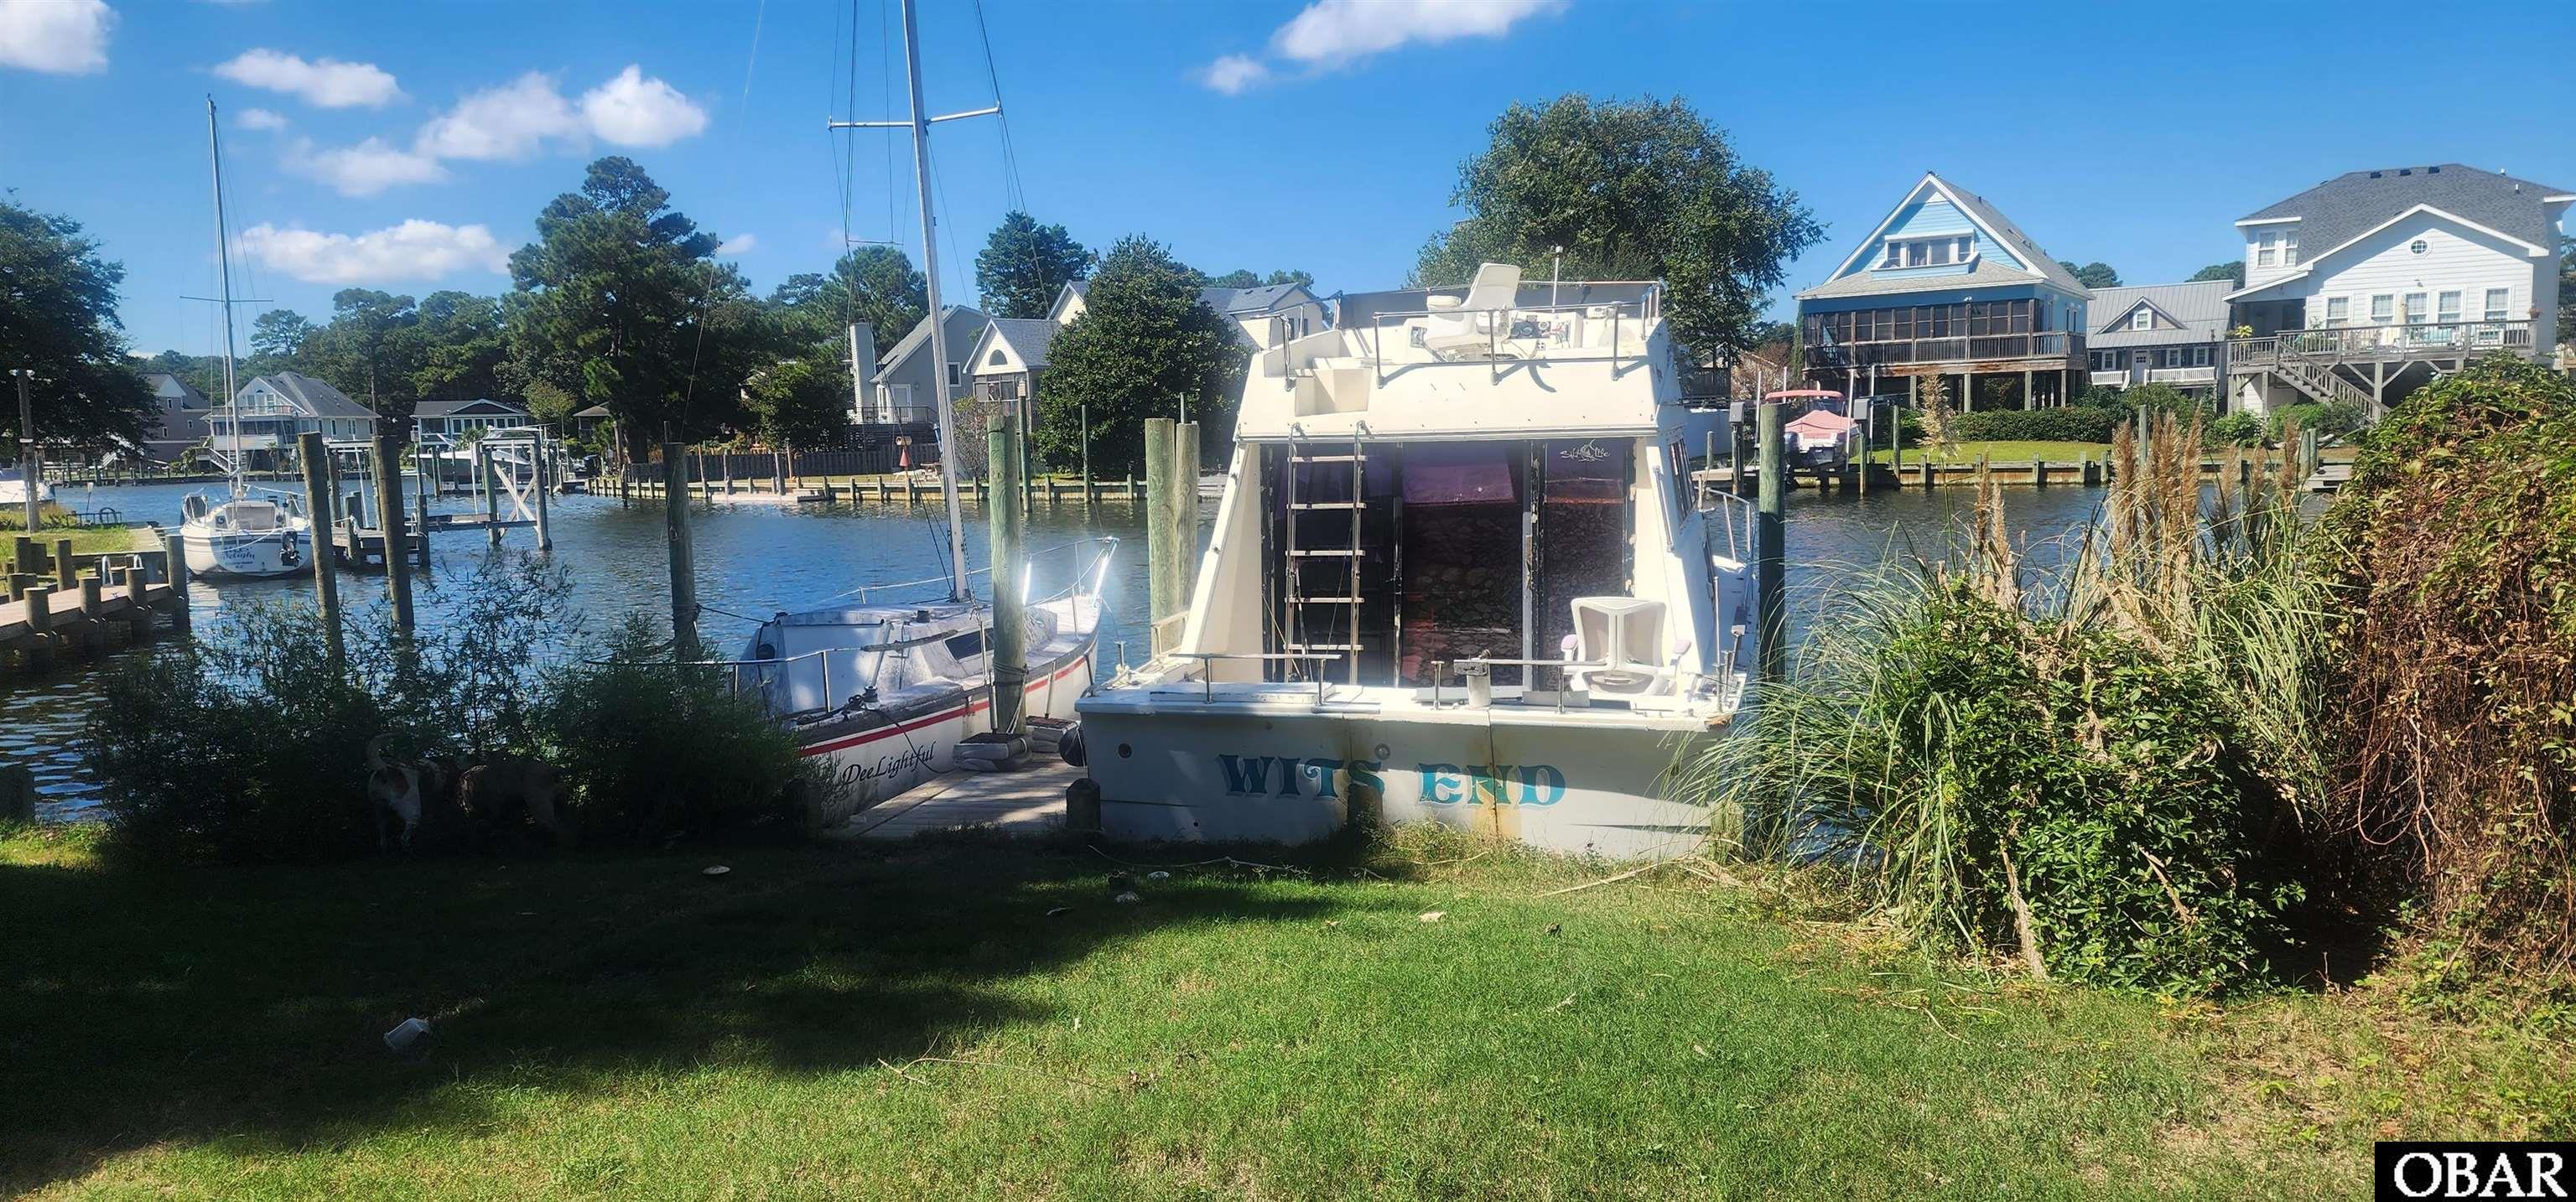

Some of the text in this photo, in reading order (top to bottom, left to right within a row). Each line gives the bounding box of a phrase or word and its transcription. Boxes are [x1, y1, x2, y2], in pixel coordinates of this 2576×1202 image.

[841, 740, 937, 786] DeeLightful
[1218, 754, 1567, 807] WITS END
